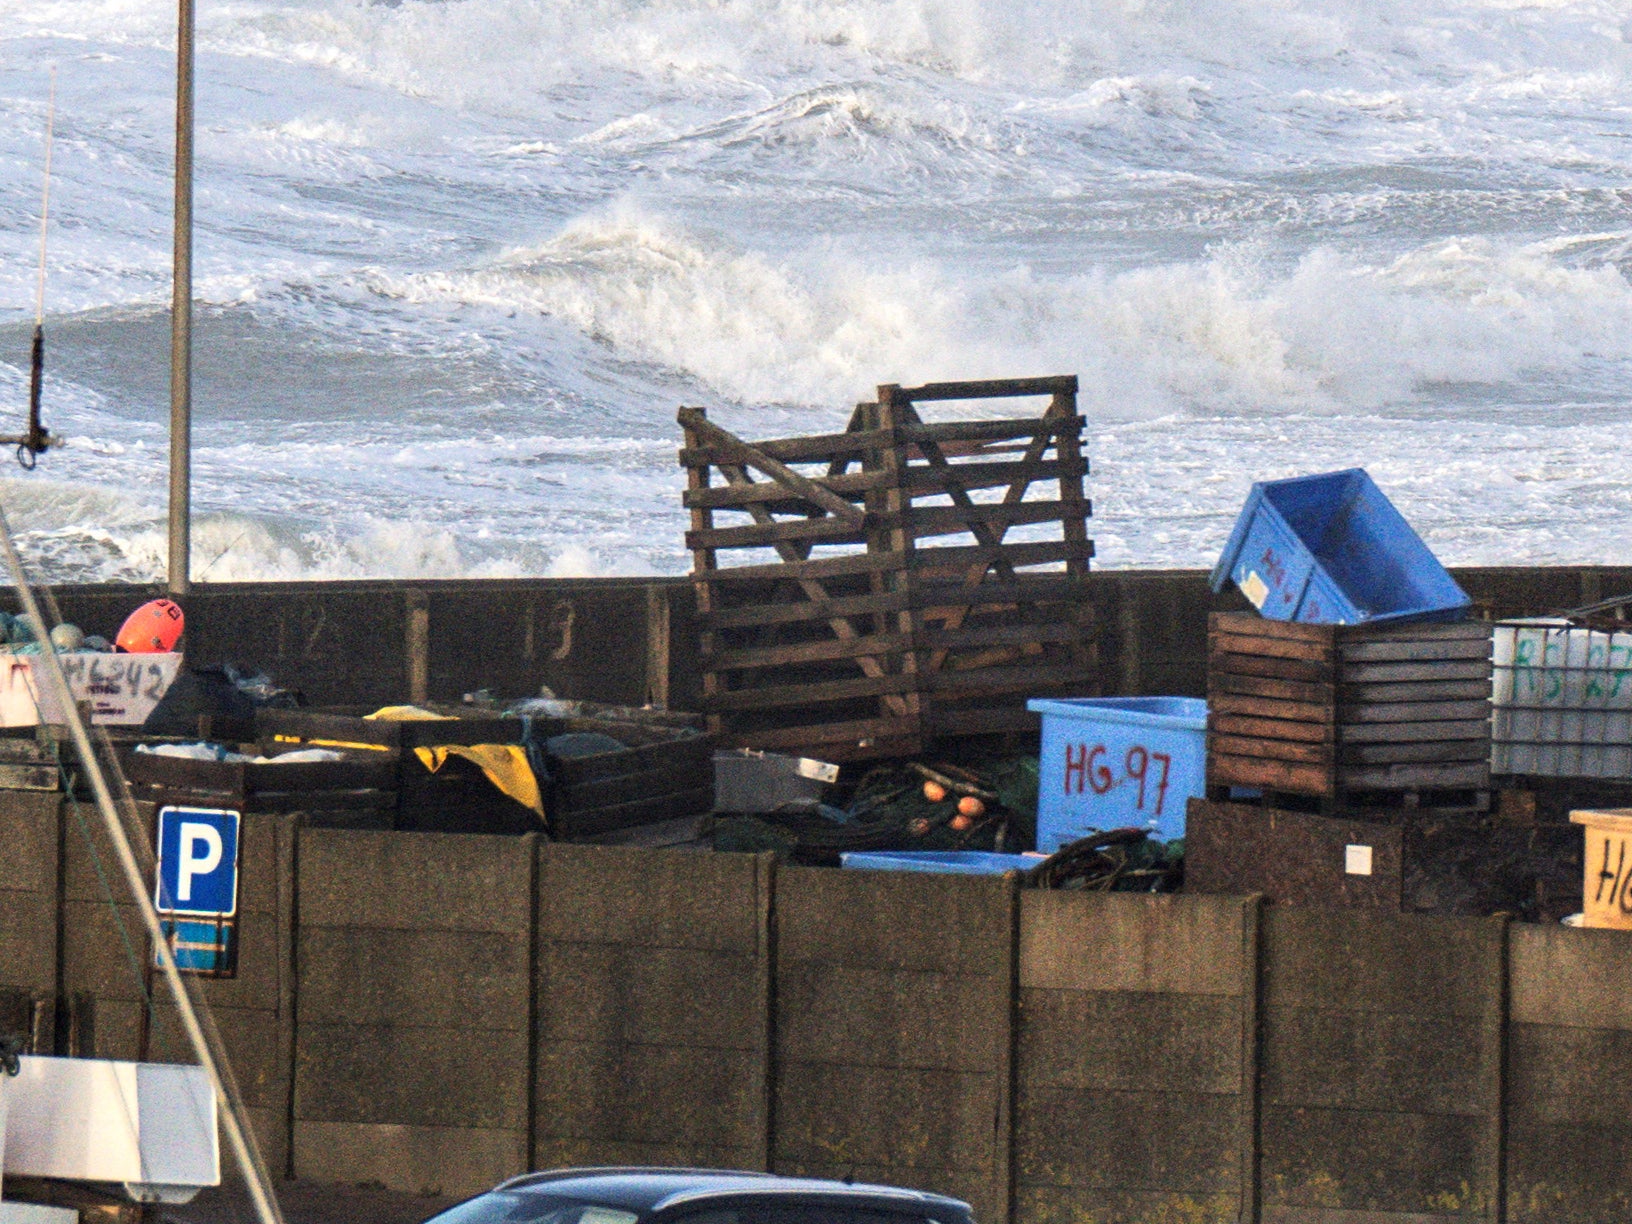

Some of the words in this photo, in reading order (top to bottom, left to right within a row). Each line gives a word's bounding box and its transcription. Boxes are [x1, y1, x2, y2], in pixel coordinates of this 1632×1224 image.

[1064, 743, 1112, 796] HG
[1125, 745, 1171, 817] 97
[177, 822, 223, 901] P
